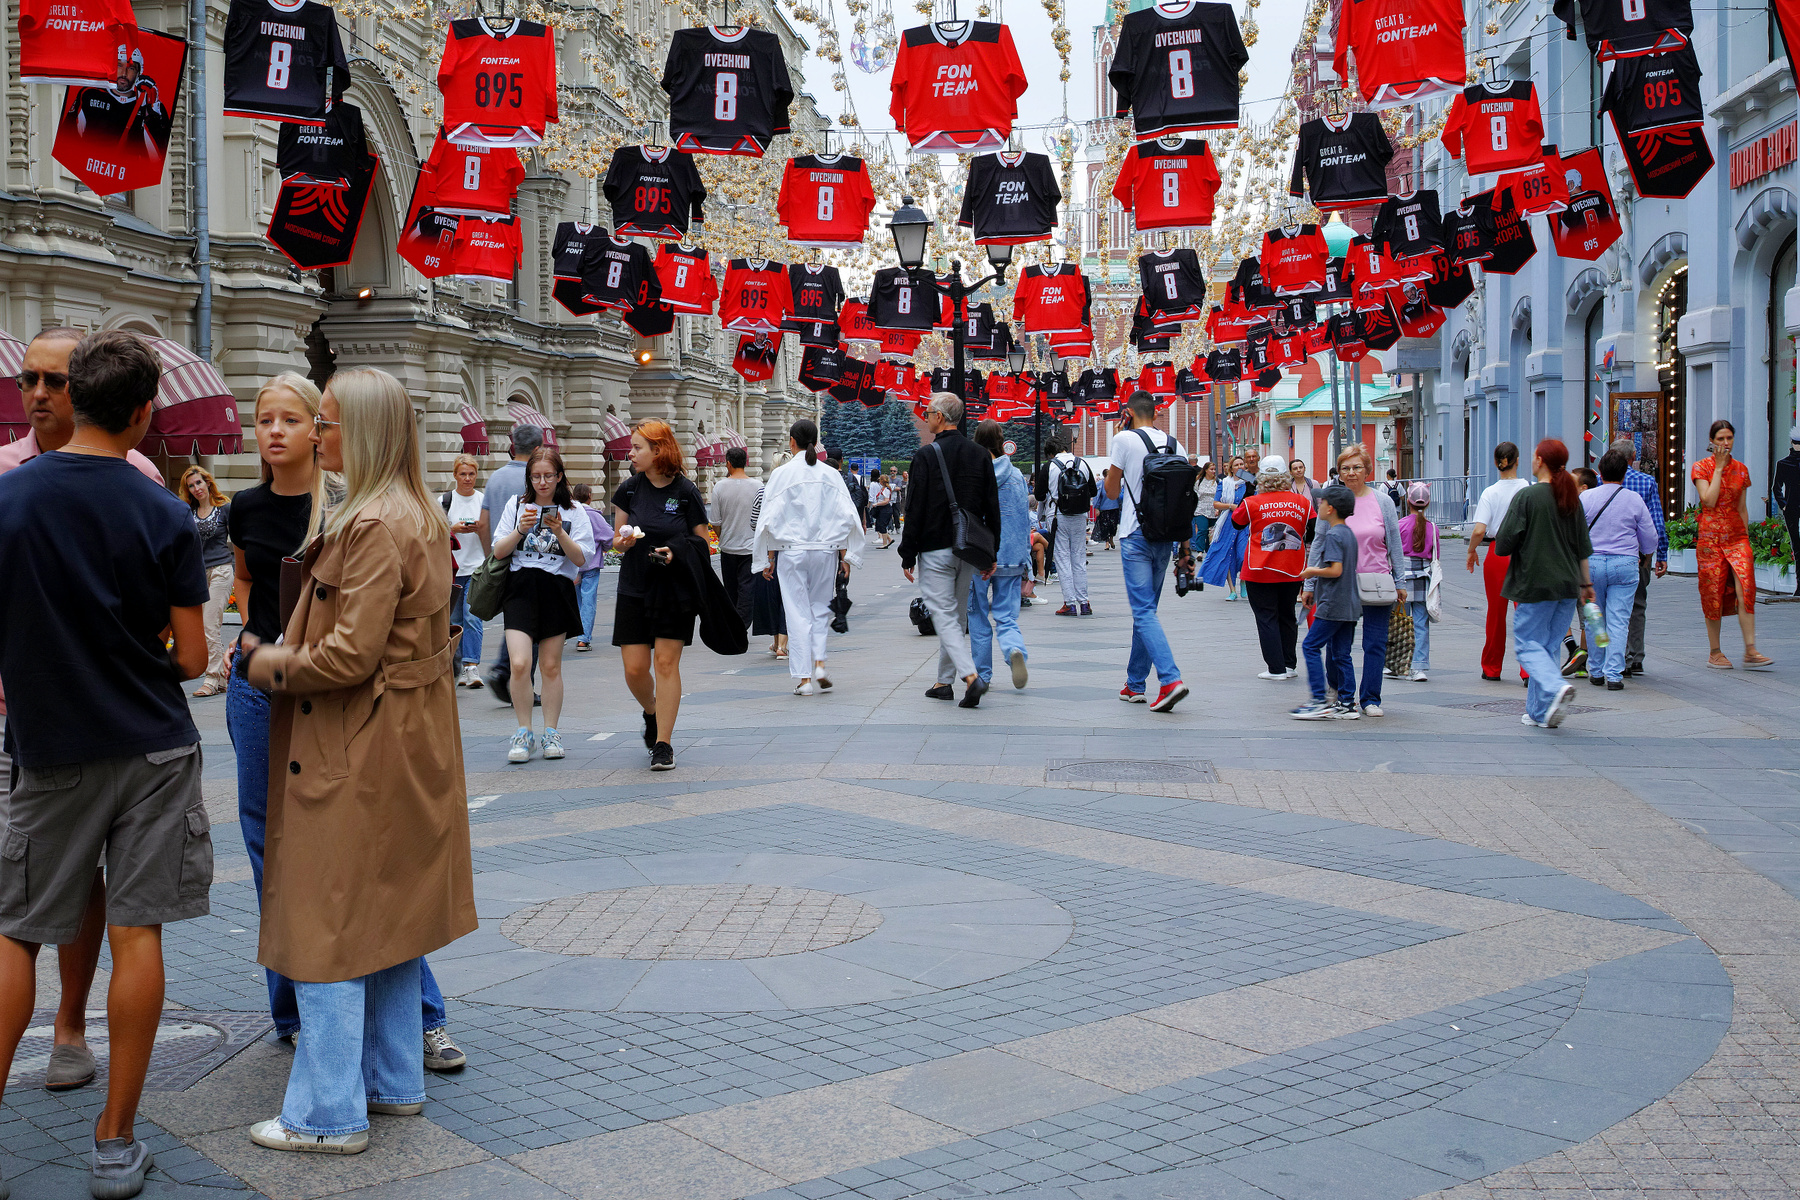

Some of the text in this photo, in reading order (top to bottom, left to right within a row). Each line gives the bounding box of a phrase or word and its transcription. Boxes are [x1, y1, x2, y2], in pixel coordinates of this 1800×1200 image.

[72, 6, 76, 16] 8
[45, 19, 105, 32] FONTEAM
[1375, 13, 1404, 30] GREAT 8
[260, 21, 306, 41] OVECHKIN
[1155, 29, 1202, 48] OVECHKIN
[1376, 23, 1437, 45] FONTEAM
[266, 40, 292, 90] 8
[480, 57, 520, 65] FONTEAM
[704, 53, 750, 69] OVECHKIN
[937, 64, 972, 79] FON
[1168, 48, 1195, 99] 8
[1646, 68, 1674, 78] FONTEAM
[475, 72, 524, 108] 895
[932, 80, 978, 97] TEAM
[1644, 79, 1682, 110] 895
[90, 98, 106, 110] GREAT
[714, 72, 738, 122] 8
[1481, 102, 1514, 114] OVECHKIN
[300, 126, 323, 134] GREAT 8
[1490, 116, 1508, 151] 8
[297, 136, 344, 146] FONTEAM
[1320, 145, 1342, 157] GREAT 8
[1730, 120, 1797, 190] НОВАЯ ЗАРЯ
[1154, 159, 1188, 169] OVECHKIN
[1320, 153, 1366, 168] FONTEAM
[86, 158, 126, 180] GREAT 8
[463, 155, 481, 190] 8
[1523, 168, 1545, 177] FONTEAM
[810, 172, 844, 183] OVECHKIN
[999, 181, 1025, 192] FON
[1163, 172, 1179, 207] 8
[1523, 176, 1551, 199] 895
[635, 186, 671, 214] 895
[818, 186, 834, 220] 8
[995, 192, 1029, 204] TEAM
[1572, 197, 1600, 212] OVECHKIN
[1397, 203, 1421, 216] OVECHKIN
[434, 215, 459, 230] OVECHK
[1495, 209, 1518, 229] НЫЙ
[284, 222, 341, 247] МОСКОВСКИЙ СПОРТ
[1404, 214, 1420, 241] 8
[470, 240, 505, 249] FONTEAM
[1456, 230, 1480, 250] 895
[1584, 238, 1598, 251] 895
[424, 255, 440, 268] 895
[674, 255, 695, 265] OVECHKIN
[1155, 262, 1180, 273] OVECHKIN
[1369, 252, 1380, 274] 8
[606, 261, 622, 288] 8
[674, 265, 688, 288] 8
[1164, 273, 1178, 300] 8
[1325, 273, 1337, 292] 8
[800, 289, 823, 307] 895
[1042, 286, 1062, 295] FON
[741, 289, 769, 309] 895
[898, 287, 912, 314] 8
[1040, 295, 1064, 304] TEAM
[1292, 304, 1302, 320] 8
[814, 322, 822, 337] 8
[854, 316, 873, 331] 895
[968, 318, 977, 336] 8
[1340, 325, 1356, 337] 895
[1418, 323, 1430, 334] GREAT
[888, 333, 904, 345] 895
[1258, 351, 1266, 363] 8
[1283, 343, 1291, 357] 8
[744, 368, 756, 377] GREAT
[896, 372, 904, 385] 8
[1156, 373, 1163, 386] 8
[942, 377, 948, 388] 8
[965, 382, 973, 392] 95
[996, 384, 1008, 393] 895
[1052, 382, 1058, 394] 8
[1259, 502, 1305, 515] АВТОБУСНАЯ
[1262, 511, 1302, 521] ЭКСКУРСИЯ
